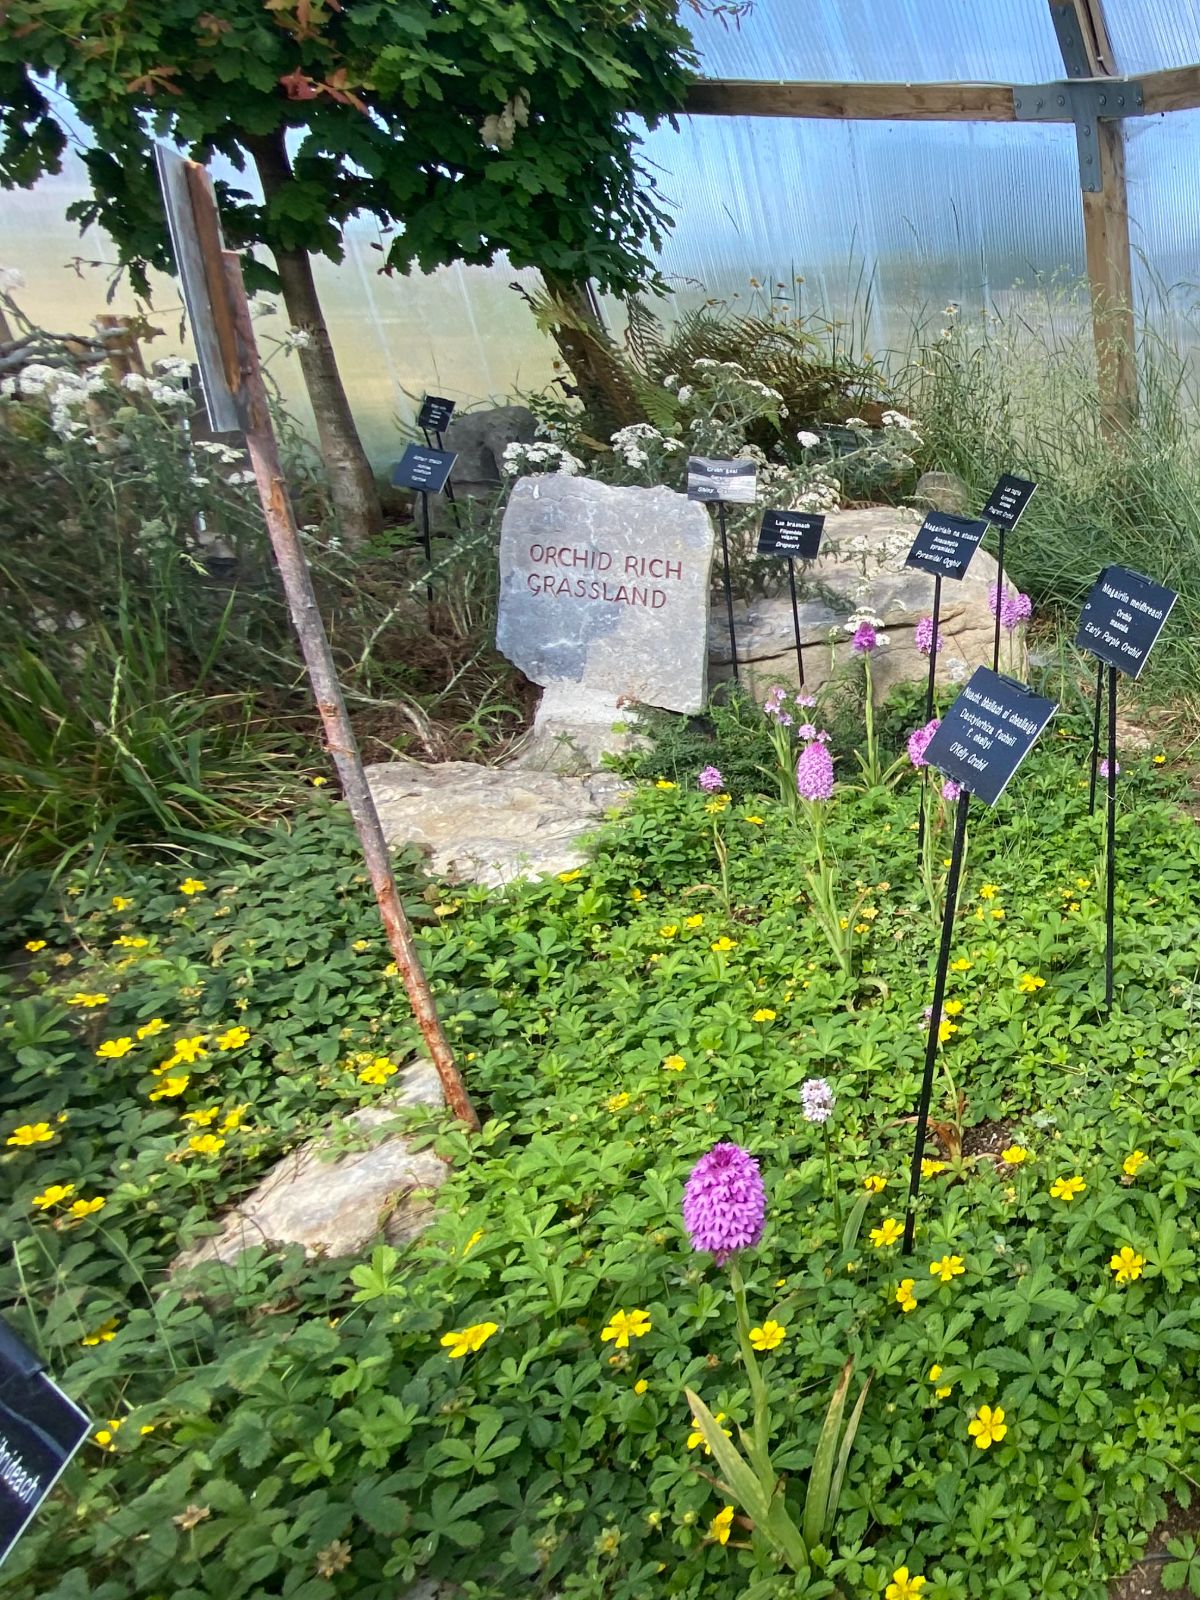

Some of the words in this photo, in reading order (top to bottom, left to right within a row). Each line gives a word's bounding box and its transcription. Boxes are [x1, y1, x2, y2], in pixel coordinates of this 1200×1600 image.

[530, 544, 612, 571] ORCHID
[624, 555, 683, 581] RICH
[527, 573, 667, 609] GRASSLAND
[1109, 618, 1130, 634] mascula
[1116, 608, 1133, 623] Orchis
[1084, 622, 1102, 638] Early
[1100, 630, 1121, 648] Purple
[1120, 642, 1143, 659] Orchid
[967, 753, 990, 771] Orchid
